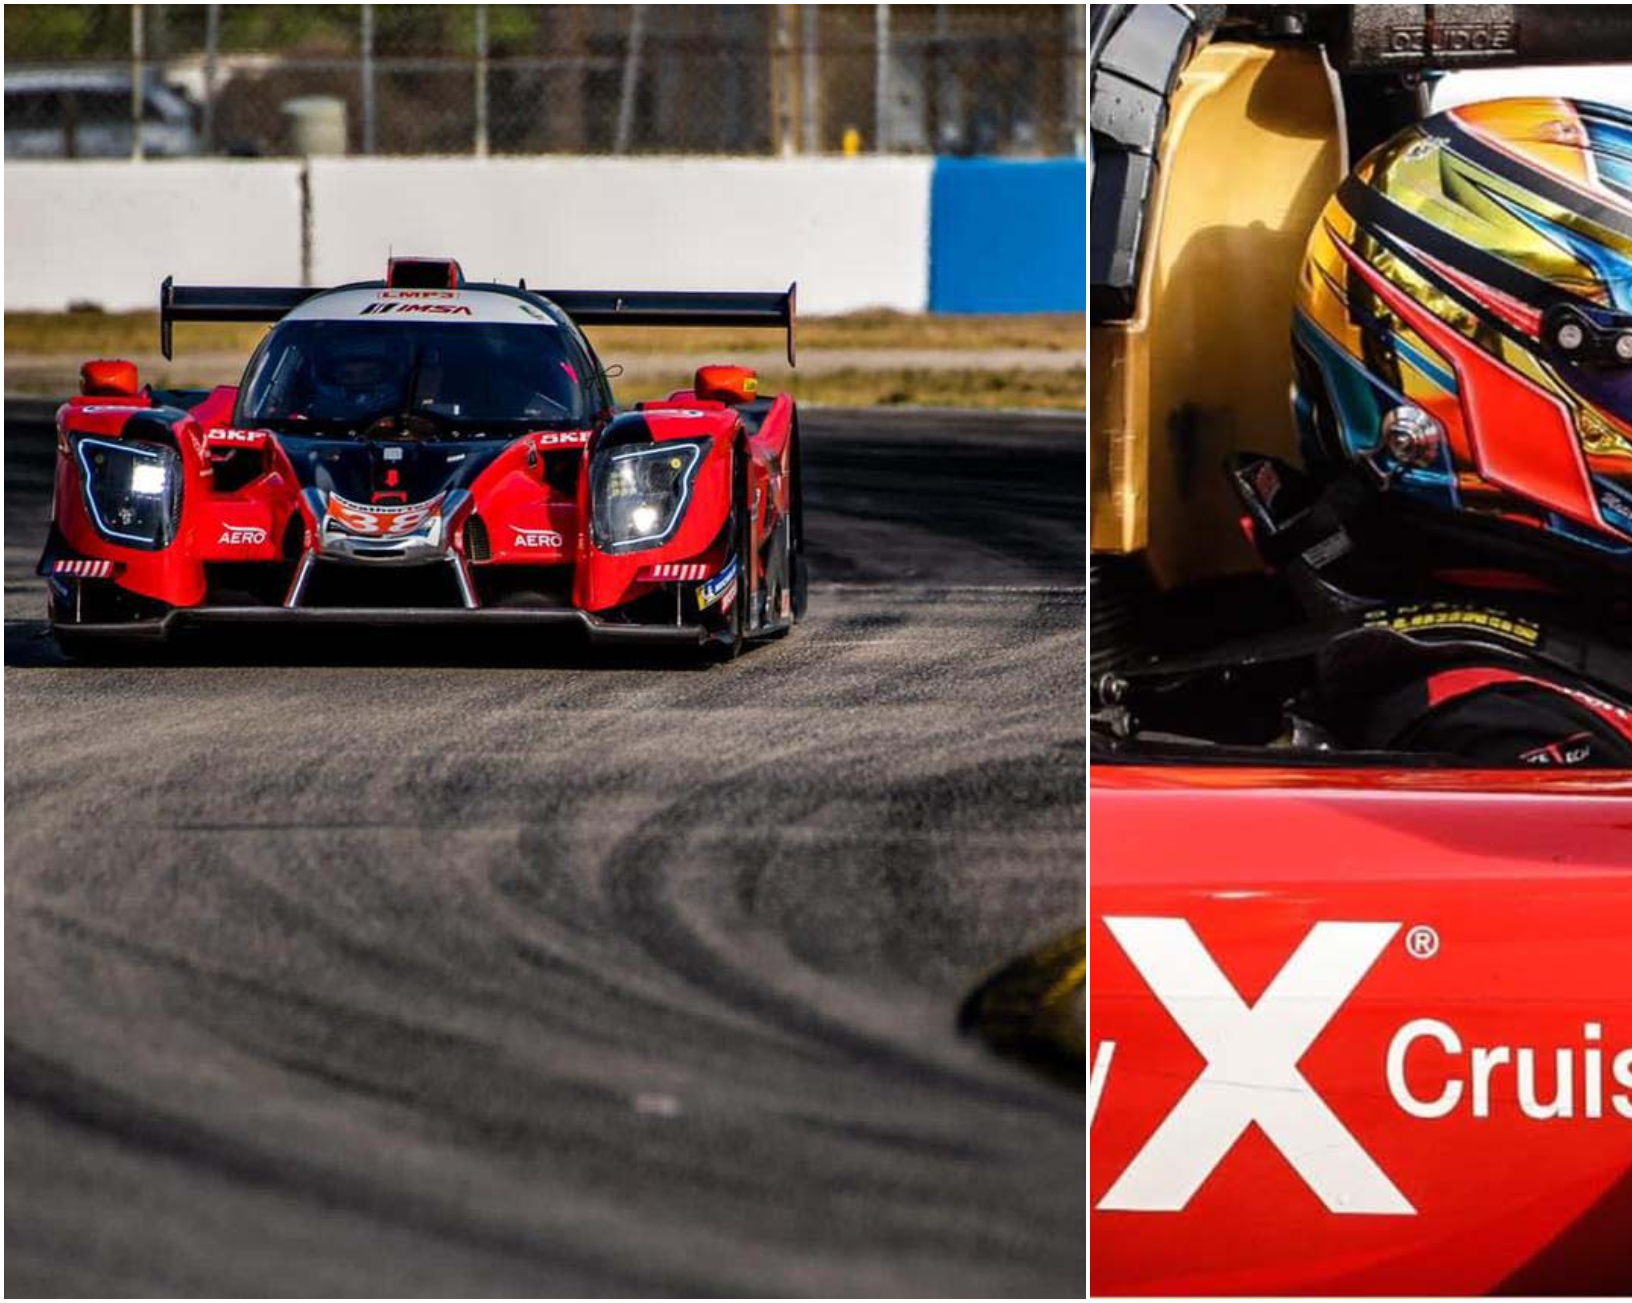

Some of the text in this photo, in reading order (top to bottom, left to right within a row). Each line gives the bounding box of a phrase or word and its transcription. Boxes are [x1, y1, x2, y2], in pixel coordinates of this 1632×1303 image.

[382, 291, 456, 299] LMP3
[396, 304, 472, 315] IMSA
[208, 429, 267, 441] SKF
[341, 508, 428, 534] 38
[218, 530, 266, 545] AERO
[514, 533, 563, 548] AERO
